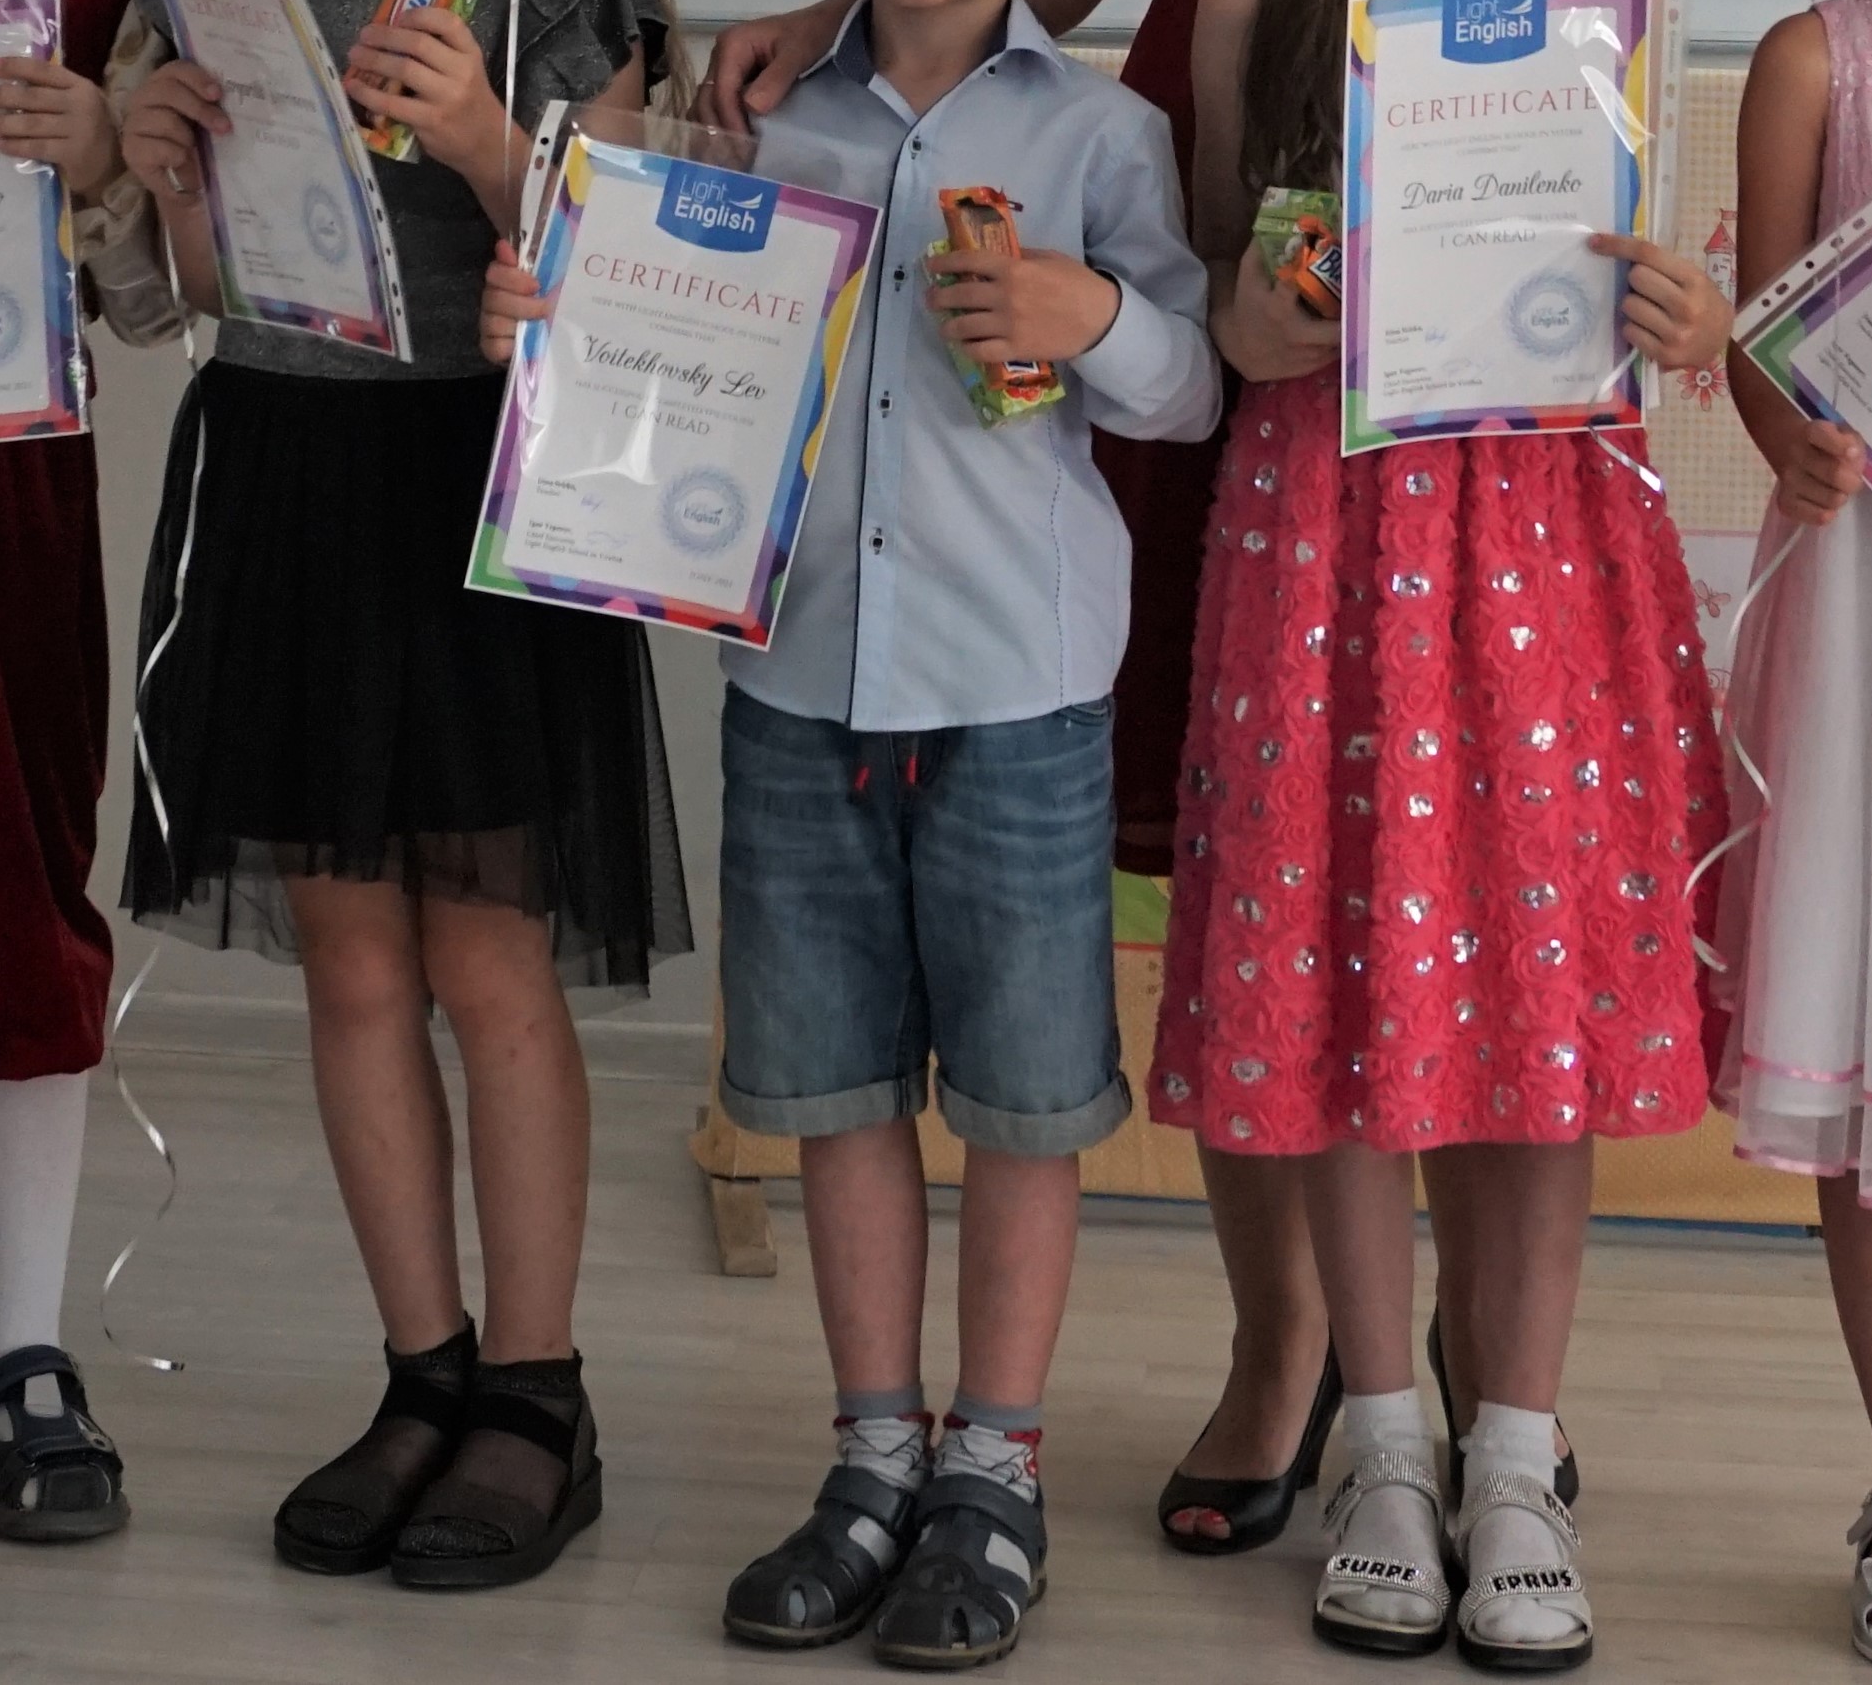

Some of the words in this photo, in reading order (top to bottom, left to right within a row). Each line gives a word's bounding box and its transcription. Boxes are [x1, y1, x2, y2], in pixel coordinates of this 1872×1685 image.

[1455, 16, 1533, 47] English
[1387, 86, 1600, 129] CERTIFICATE
[1400, 181, 1464, 211] Daria
[1470, 171, 1583, 202] Danilenko
[673, 196, 756, 234] English
[1452, 229, 1488, 247] CAN
[1492, 227, 1536, 244] READ
[583, 252, 806, 326] CERTIFICATE
[582, 334, 714, 397] Voitekhovsky
[719, 369, 767, 402] Lev
[623, 404, 663, 427] CAN
[664, 411, 711, 436] READ
